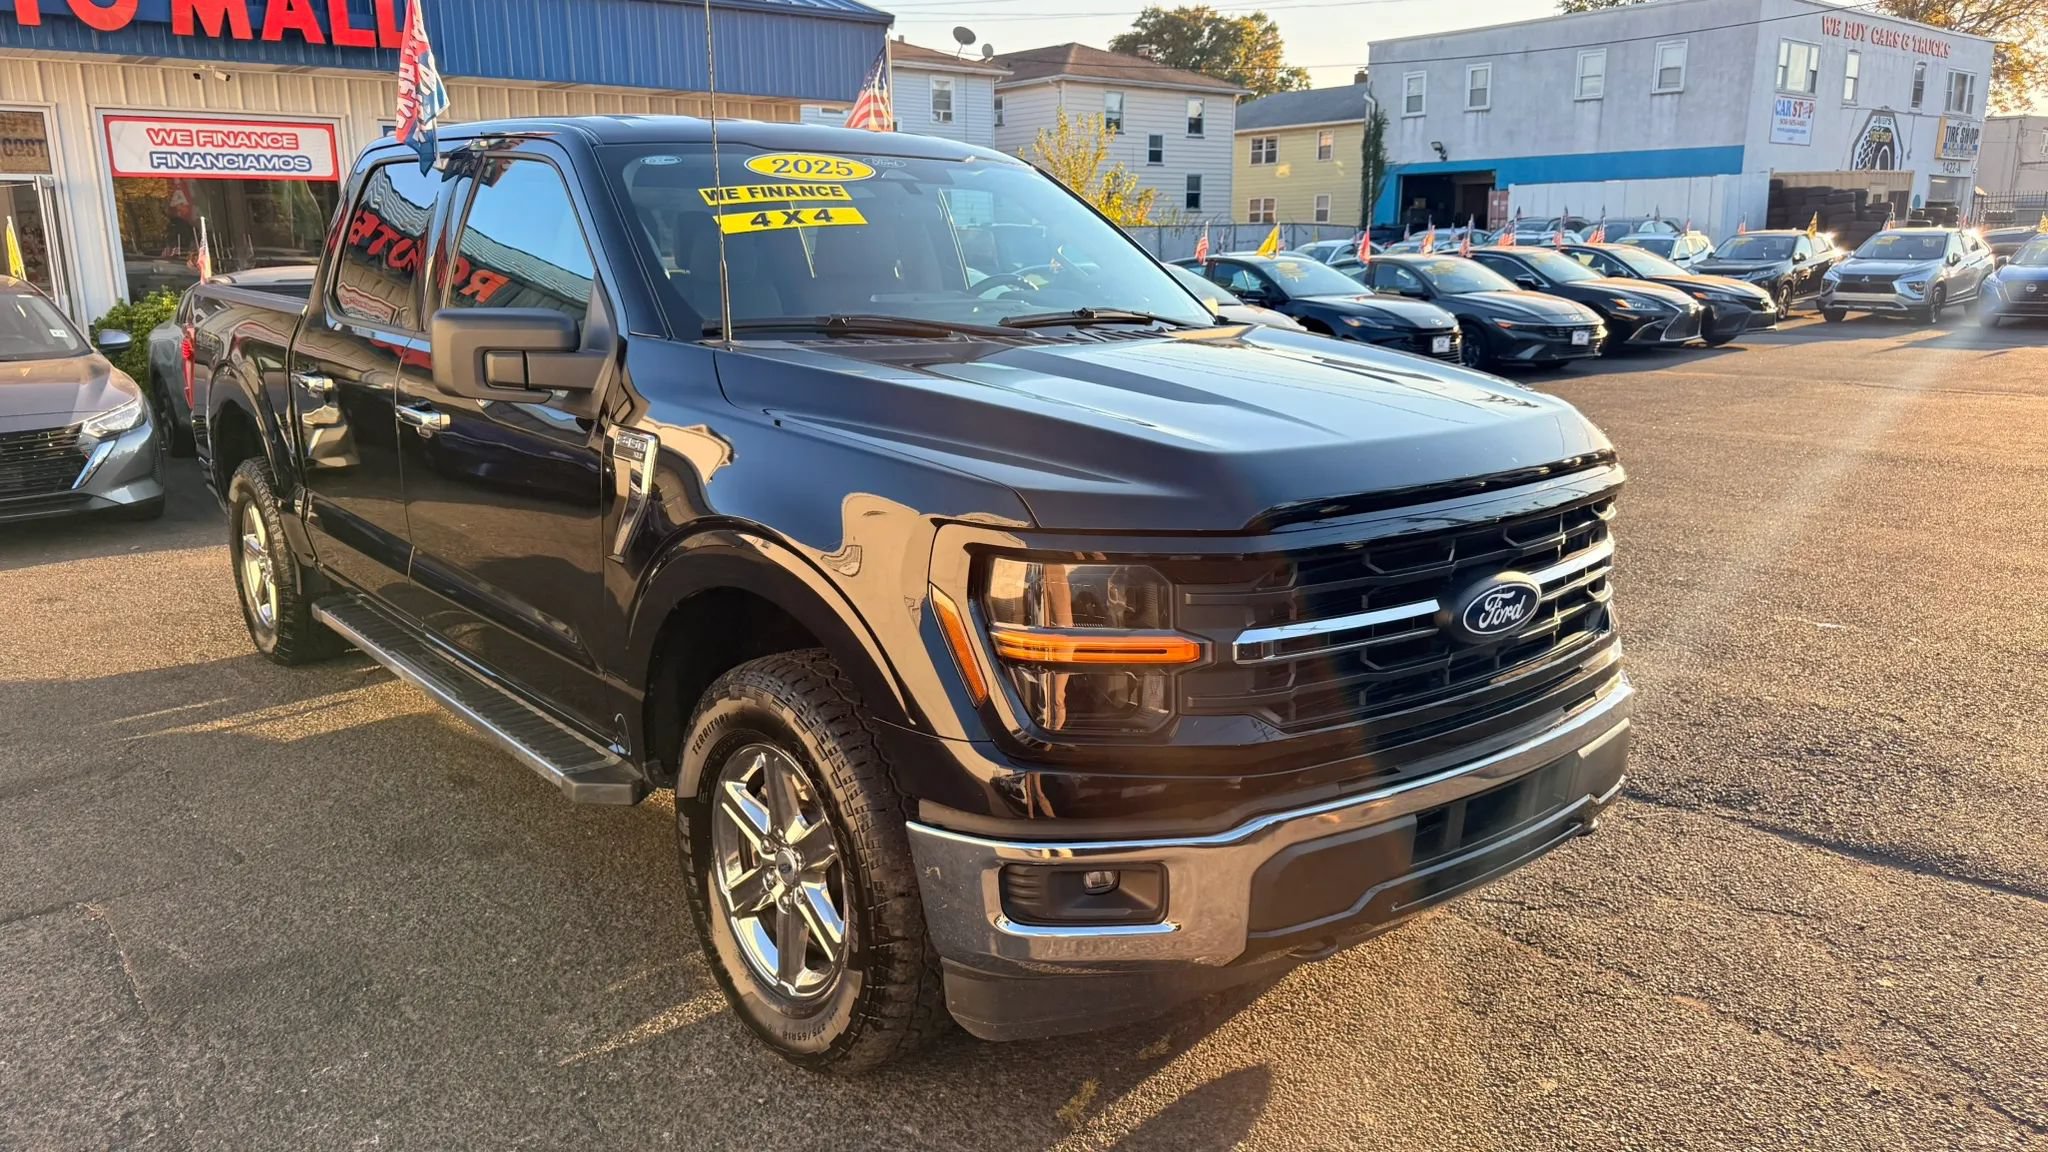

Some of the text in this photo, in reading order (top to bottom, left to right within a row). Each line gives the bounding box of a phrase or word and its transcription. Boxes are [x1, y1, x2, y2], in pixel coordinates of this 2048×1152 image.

[172, 0, 406, 49] MALL
[1822, 16, 1841, 37] WE
[1844, 21, 1867, 42] BUY
[1871, 27, 1900, 49] CARS
[1912, 34, 1951, 59] TRUCKS
[1775, 99, 1792, 118] CAR
[146, 128, 299, 150] WE FINANCE
[1945, 125, 1979, 145] TIRE SHOP
[150, 151, 312, 171] FINANCIAMOS
[772, 158, 853, 177] 2025
[703, 184, 844, 202] WE FINANCE
[1478, 590, 1527, 629] Ford
[692, 711, 729, 755] TERRITORY
